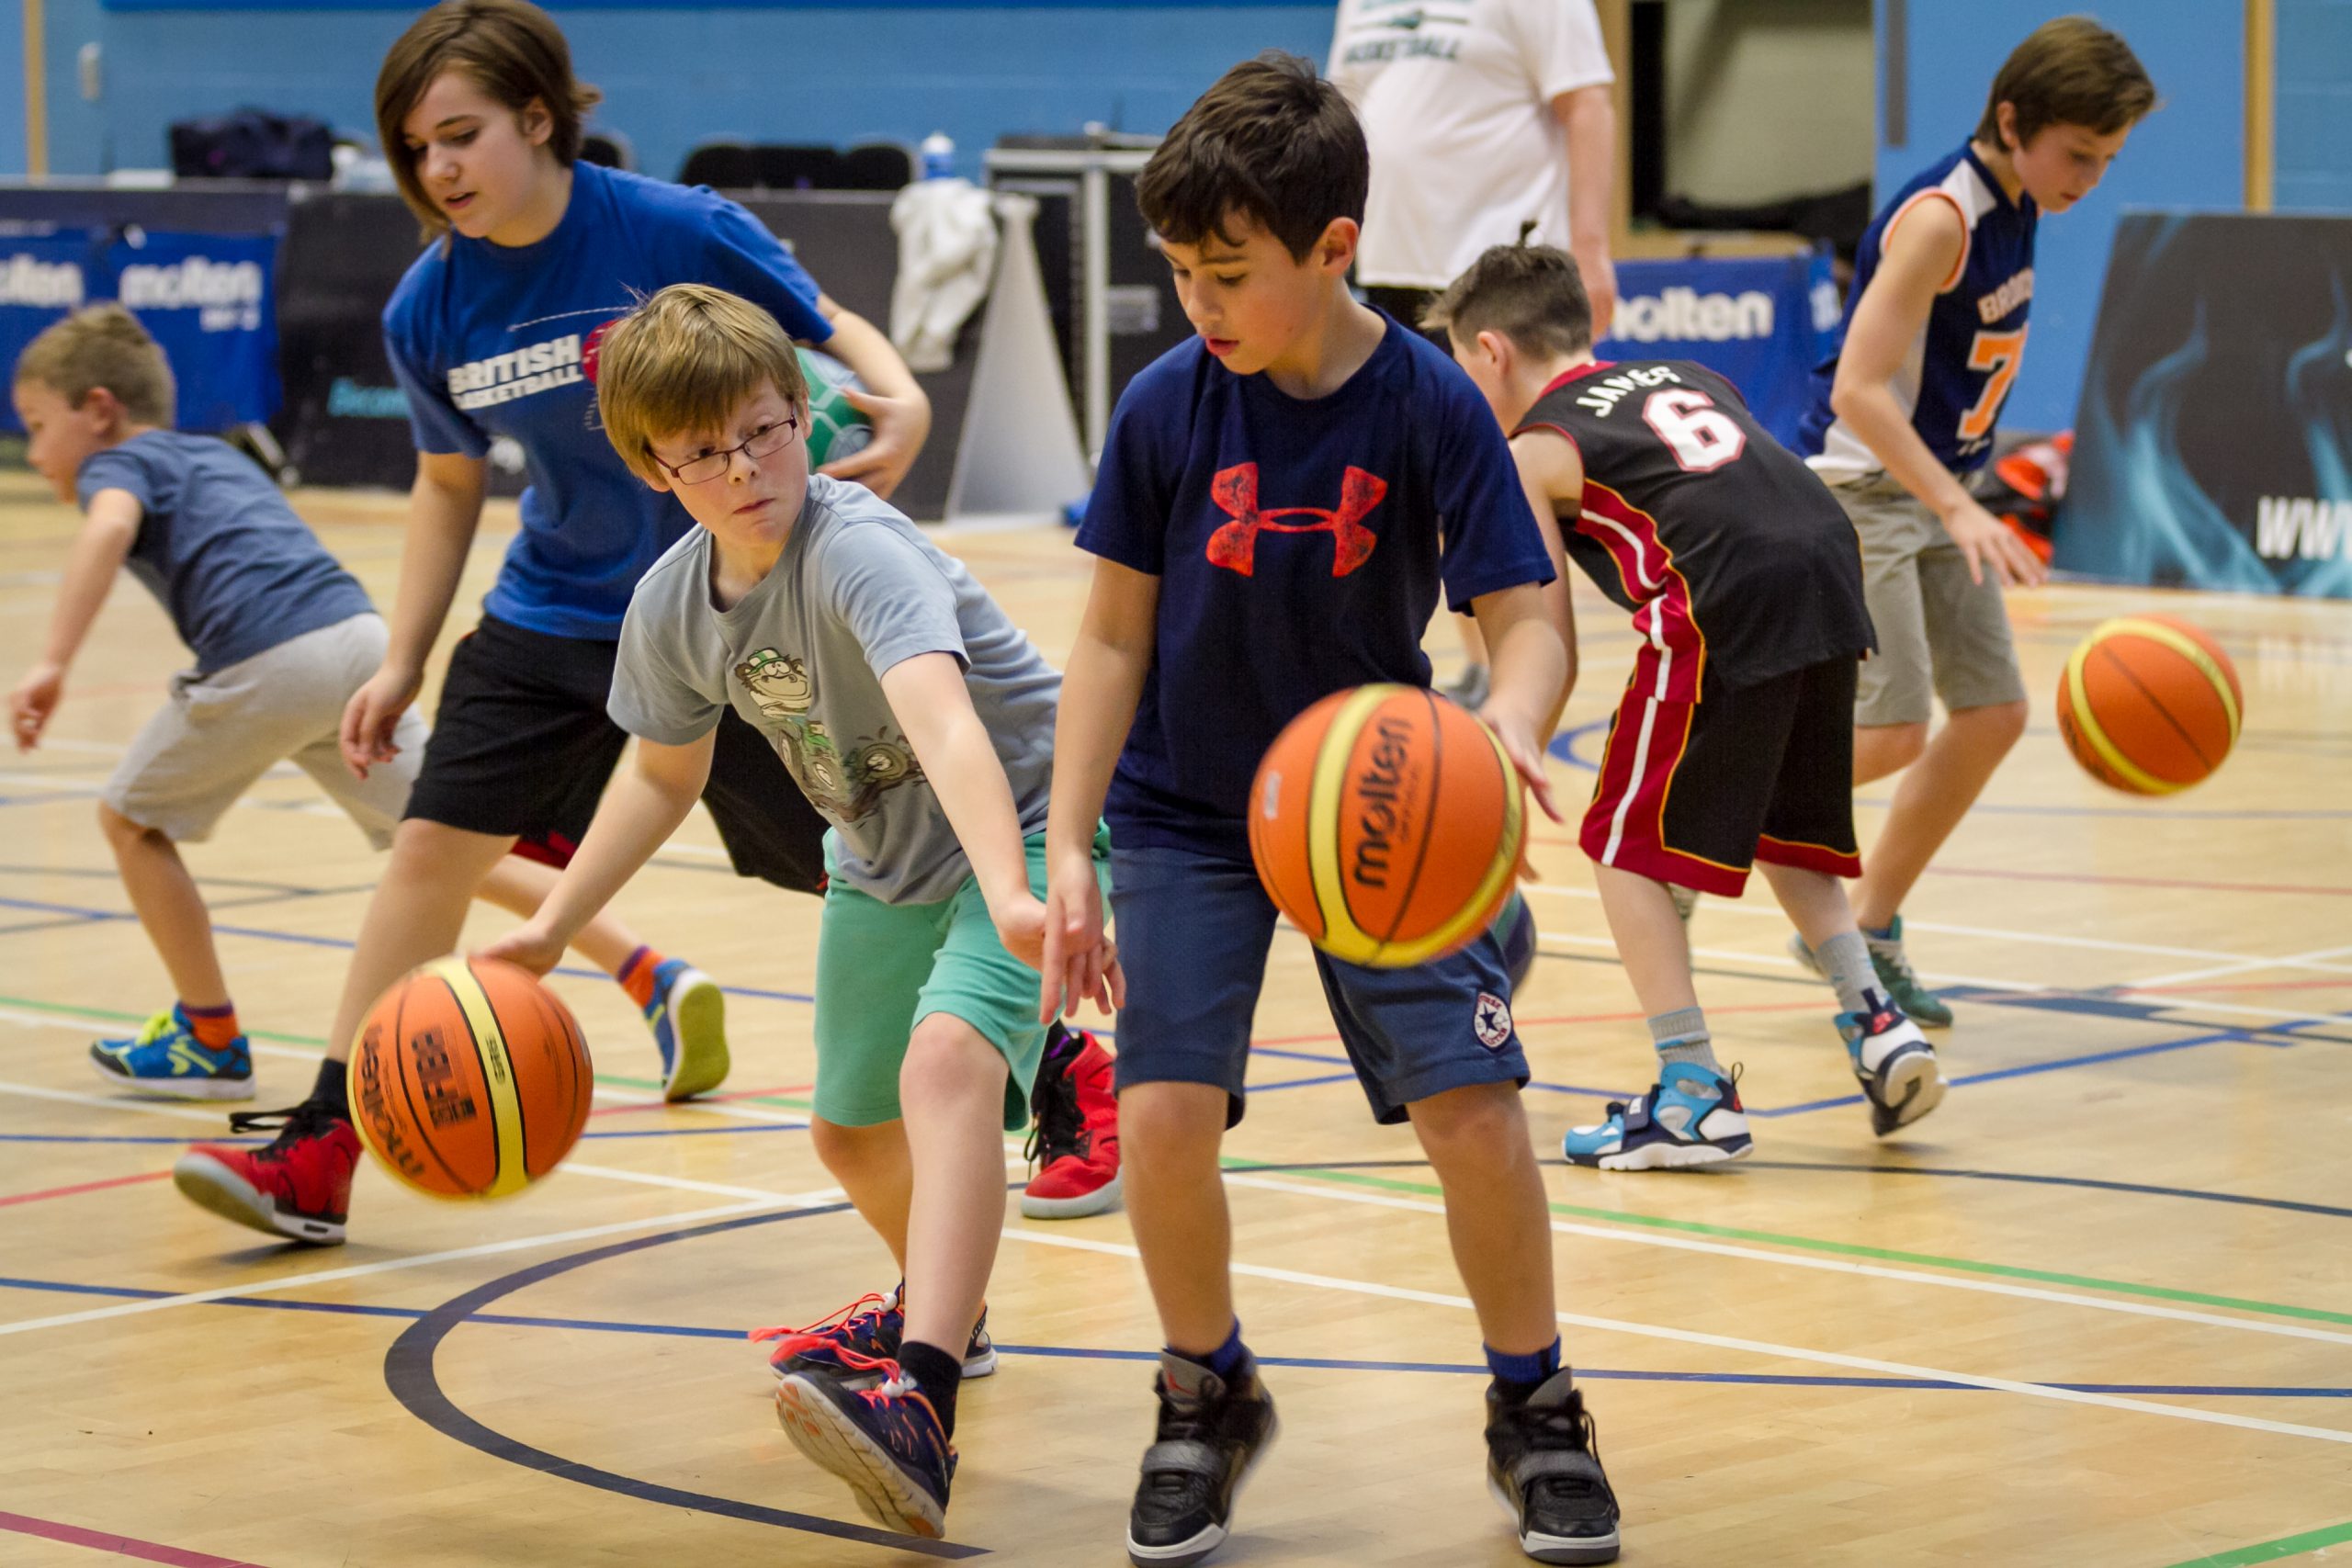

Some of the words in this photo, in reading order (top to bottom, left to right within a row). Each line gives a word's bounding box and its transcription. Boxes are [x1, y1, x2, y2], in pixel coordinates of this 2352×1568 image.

[447, 333, 581, 395] BRITISH
[1577, 366, 1681, 419] JAMES
[1957, 321, 2029, 440] 7
[1642, 389, 1747, 473] 6
[1353, 716, 1413, 888] molten
